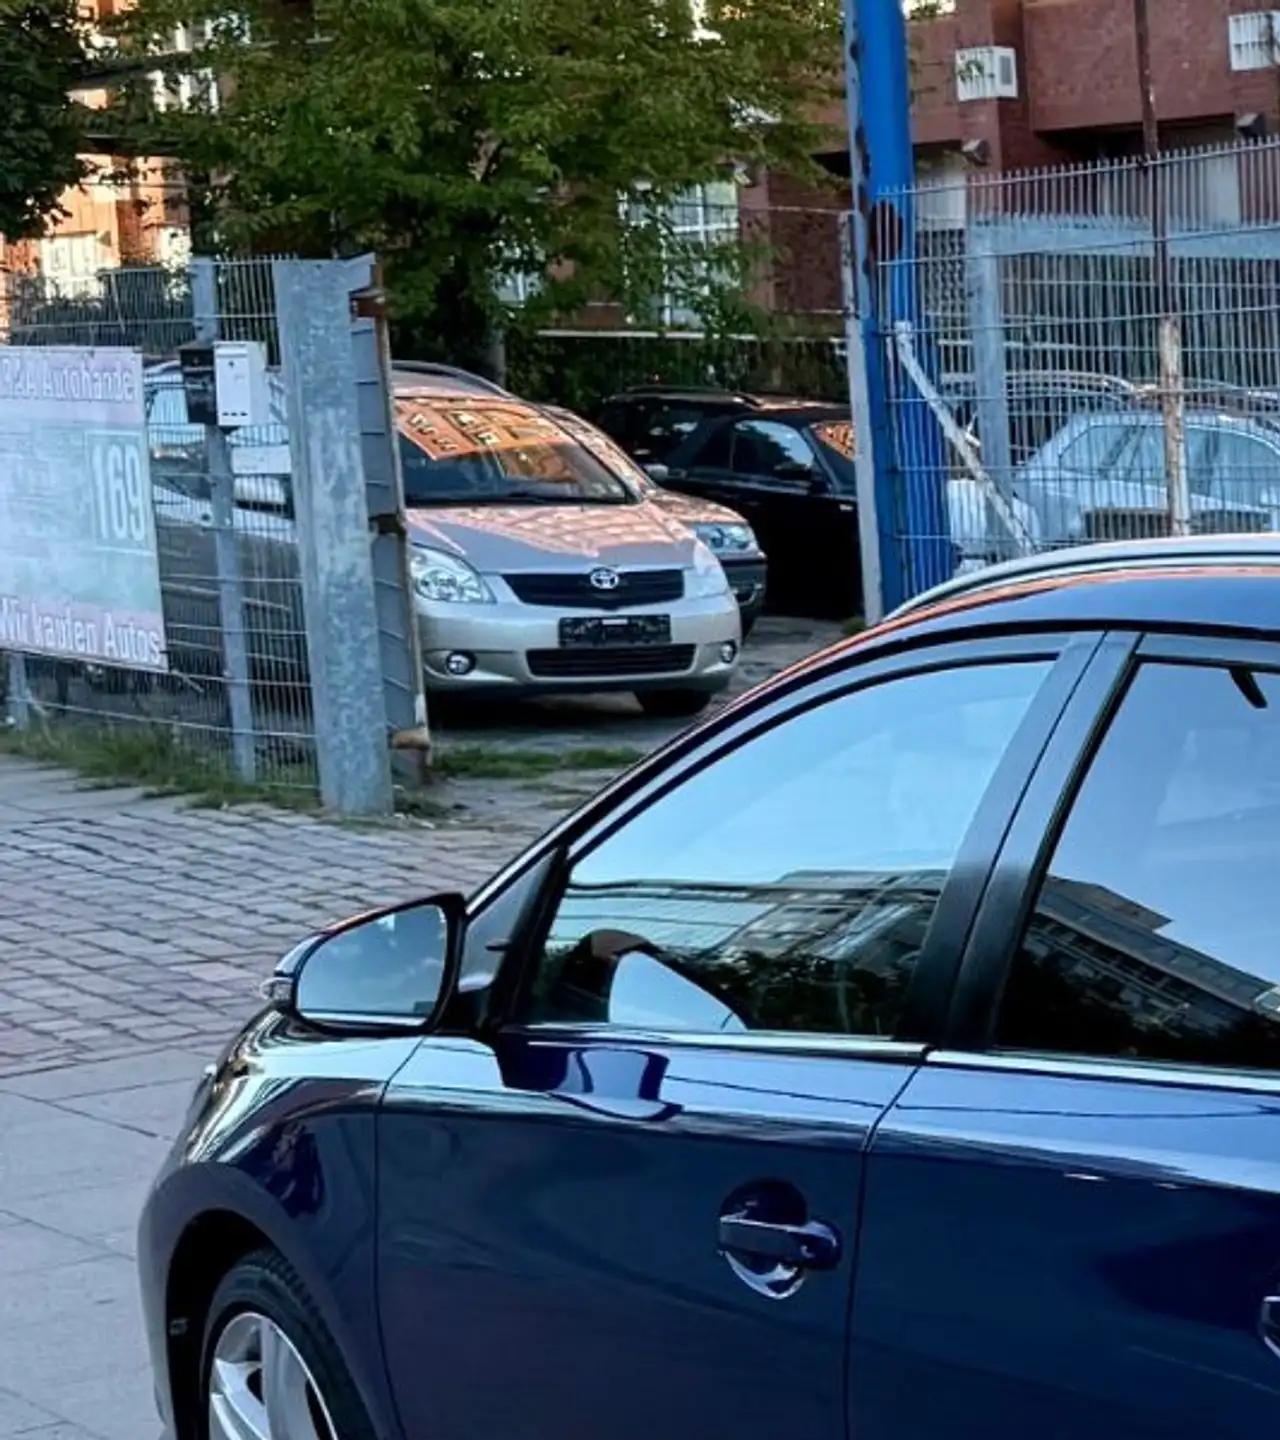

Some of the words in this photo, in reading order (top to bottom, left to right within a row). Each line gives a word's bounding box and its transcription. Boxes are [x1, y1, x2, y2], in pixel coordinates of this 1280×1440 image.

[93, 444, 146, 542] 169
[31, 602, 97, 656] kaufen
[104, 612, 160, 664] Autos
